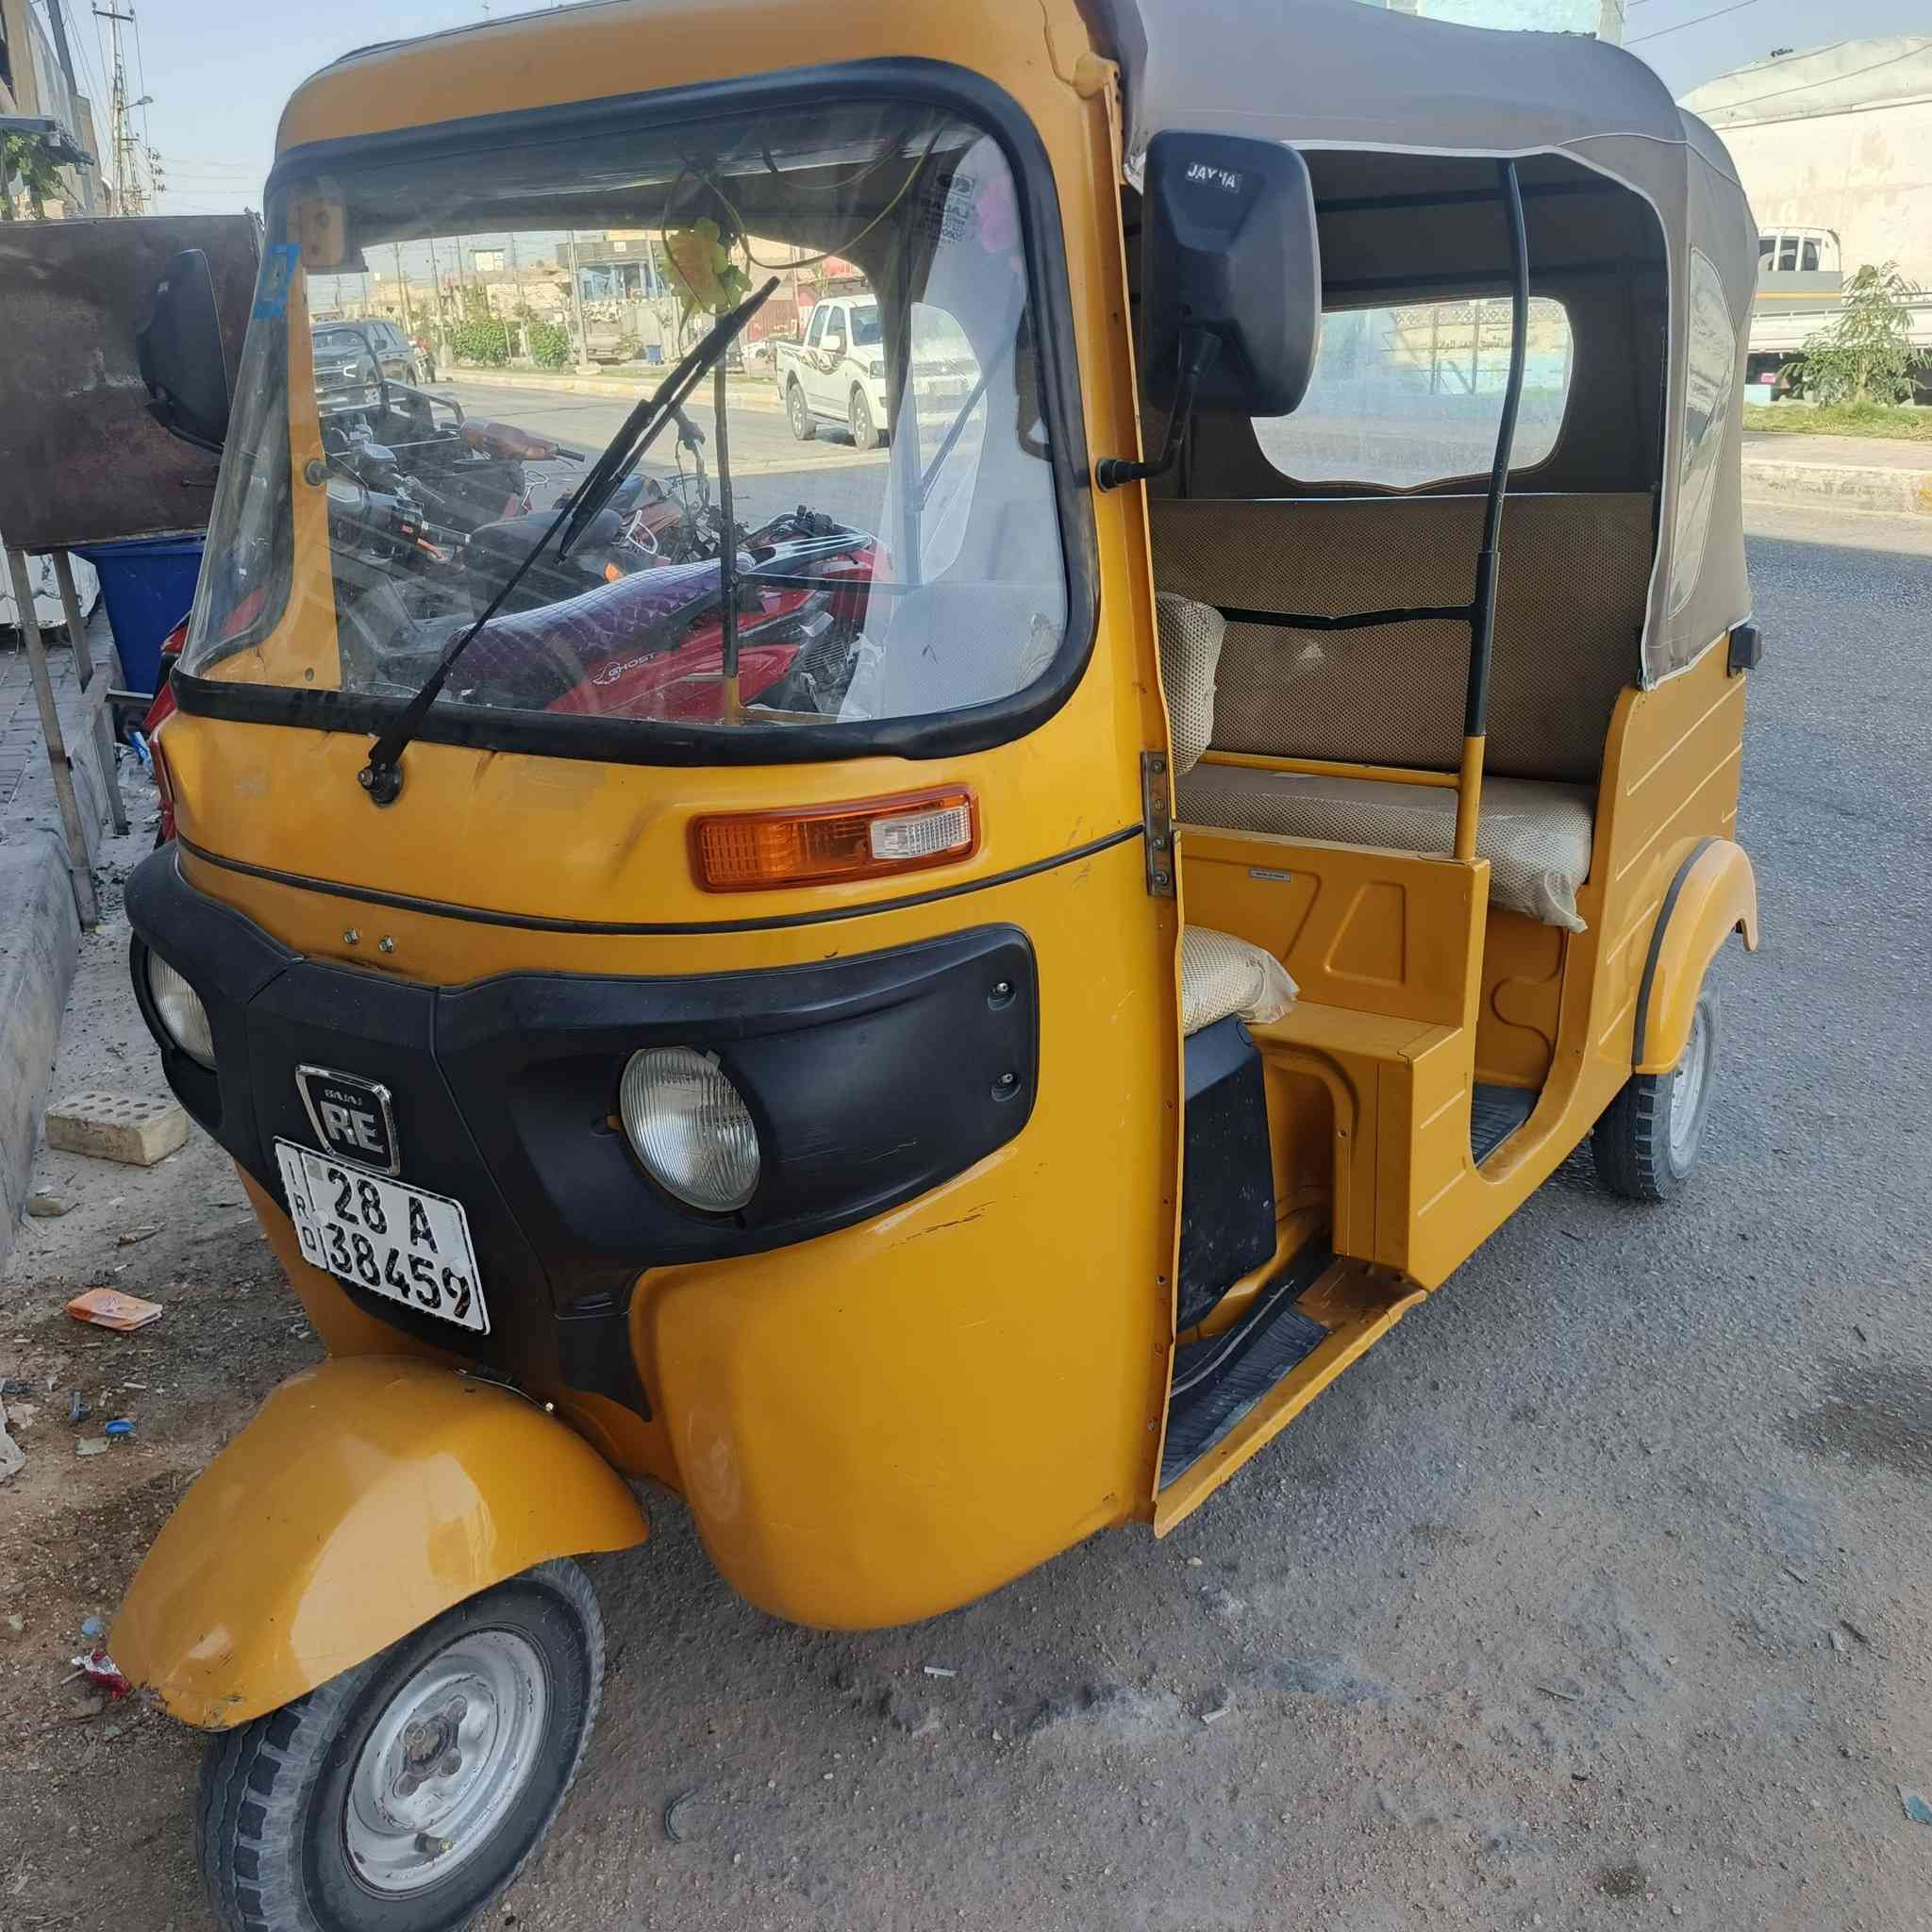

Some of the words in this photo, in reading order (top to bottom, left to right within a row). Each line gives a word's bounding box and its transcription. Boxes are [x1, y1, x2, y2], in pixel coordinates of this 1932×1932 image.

[320, 1101, 385, 1154] RE
[327, 1167, 388, 1235] 28
[408, 1195, 439, 1254] A
[325, 1223, 472, 1319] 38459
